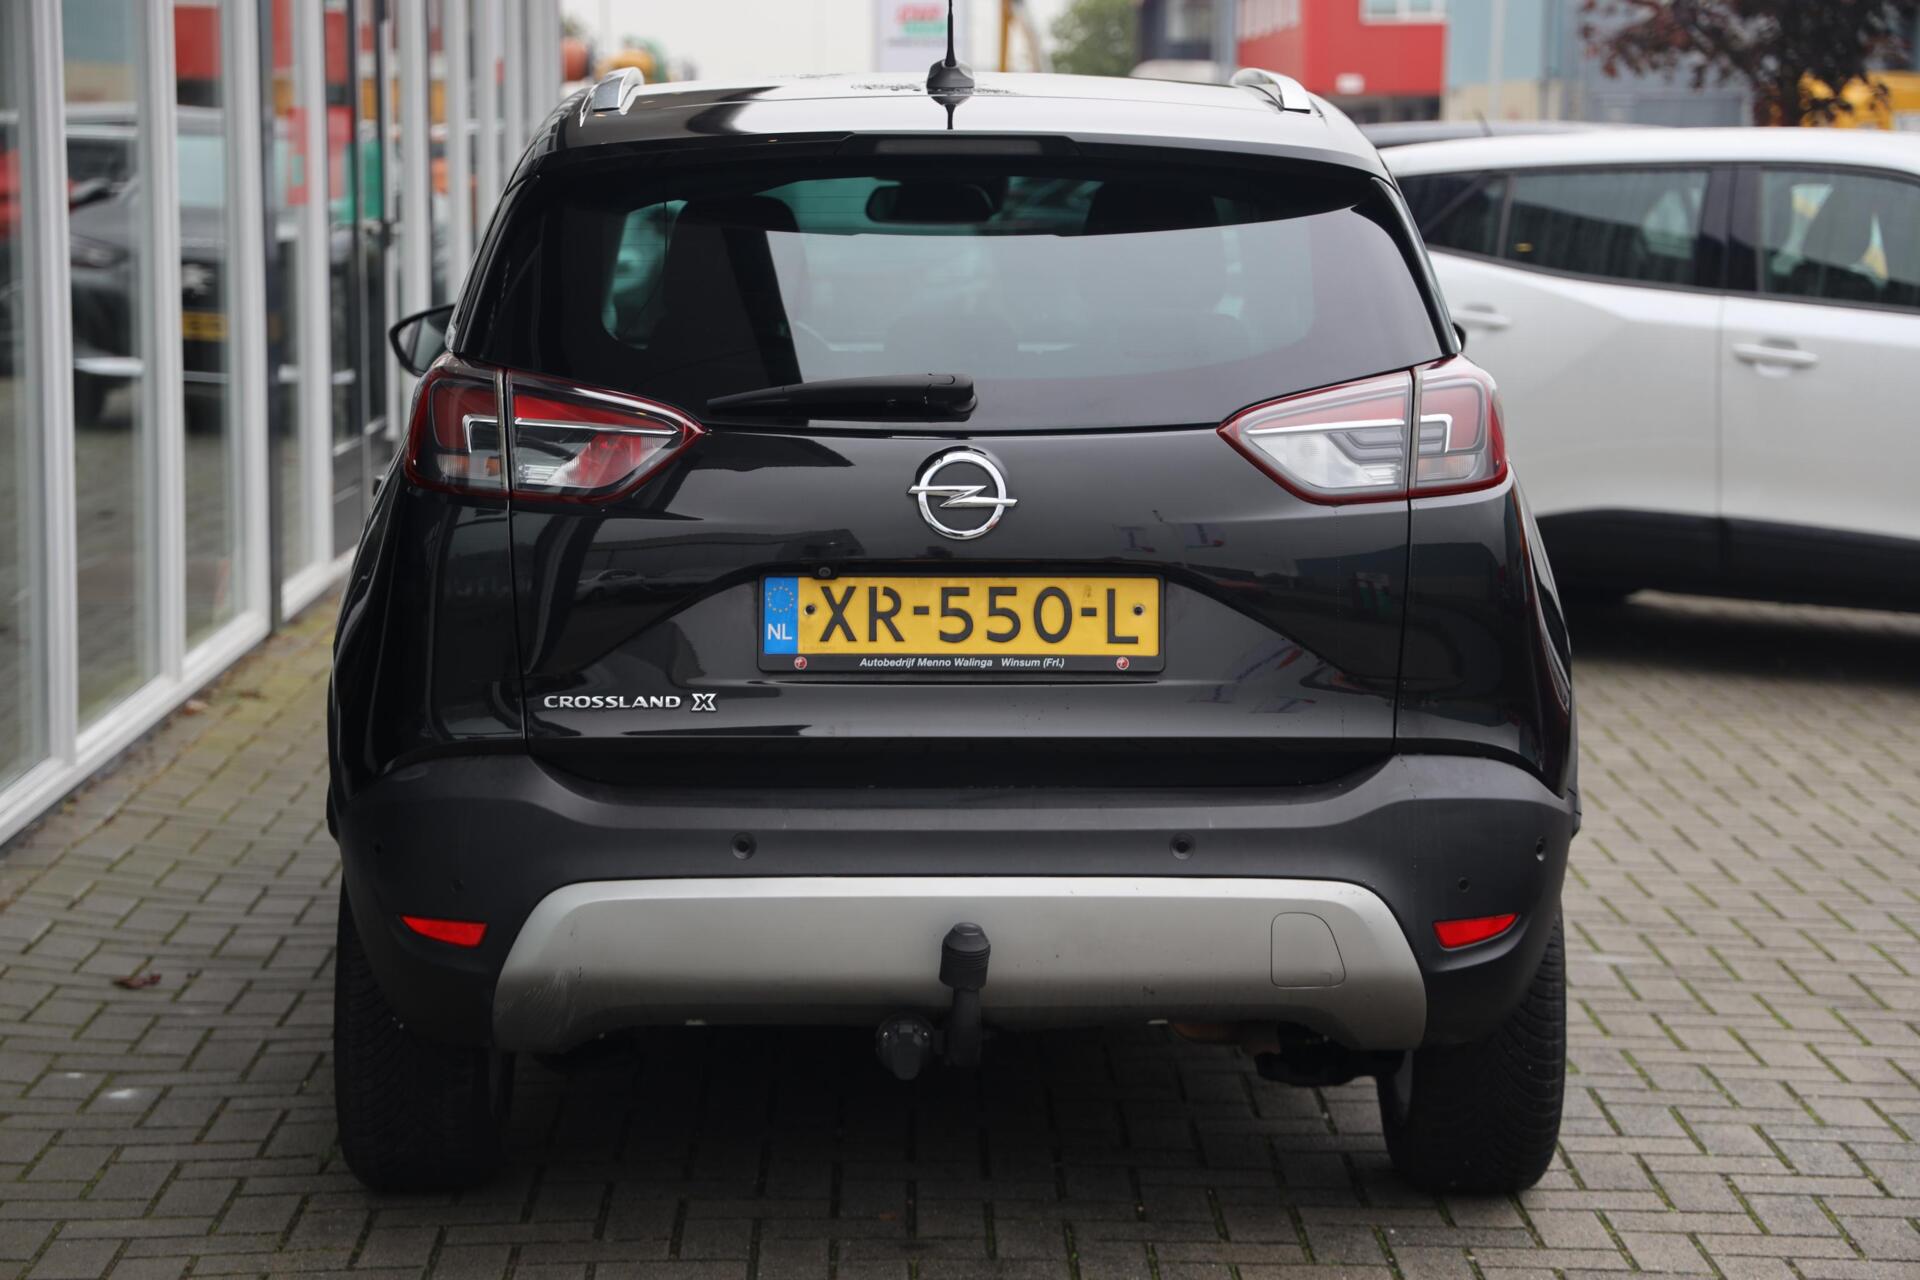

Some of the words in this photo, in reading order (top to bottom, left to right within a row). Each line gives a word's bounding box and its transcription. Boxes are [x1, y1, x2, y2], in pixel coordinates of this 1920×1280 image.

[819, 586, 1139, 644] XR-550-L
[767, 624, 793, 641] NL
[859, 657, 915, 669] Autobedrijf
[917, 657, 951, 667] Menno
[954, 657, 993, 668] Walinga
[1001, 657, 1040, 667] Winsum
[1043, 657, 1065, 669] (Frl.)
[544, 695, 681, 709] CROSSLAND
[691, 693, 717, 711] X
